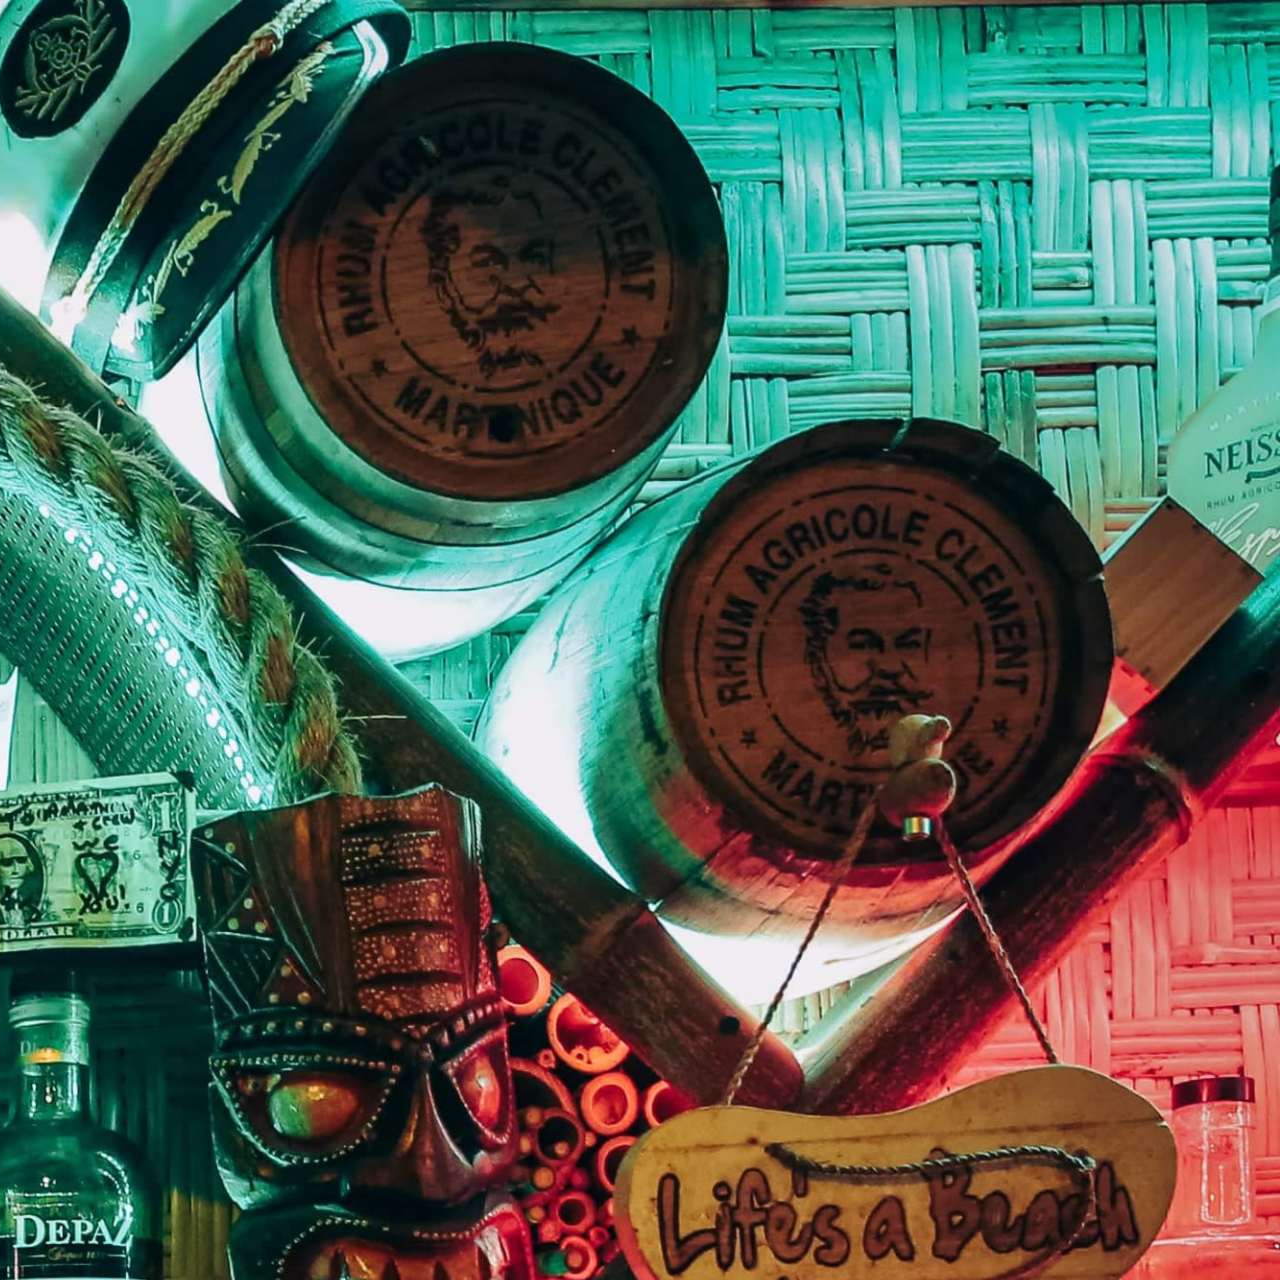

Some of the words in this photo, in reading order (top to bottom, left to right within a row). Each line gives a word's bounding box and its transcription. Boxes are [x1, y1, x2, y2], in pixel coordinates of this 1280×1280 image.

[335, 218, 379, 338] RHUM
[550, 127, 657, 302] CLEMENT
[394, 350, 627, 439] MARTNIQUE
[1206, 495, 1236, 510] RHUM
[712, 592, 758, 708] RHUM
[742, 501, 930, 595] AGRICOLE
[934, 527, 1030, 696] CLEMENT
[12, 1208, 135, 1248] DEPAZ
[656, 1165, 852, 1277] Life's
[862, 1195, 916, 1263] a
[926, 1148, 1140, 1264] Beach
